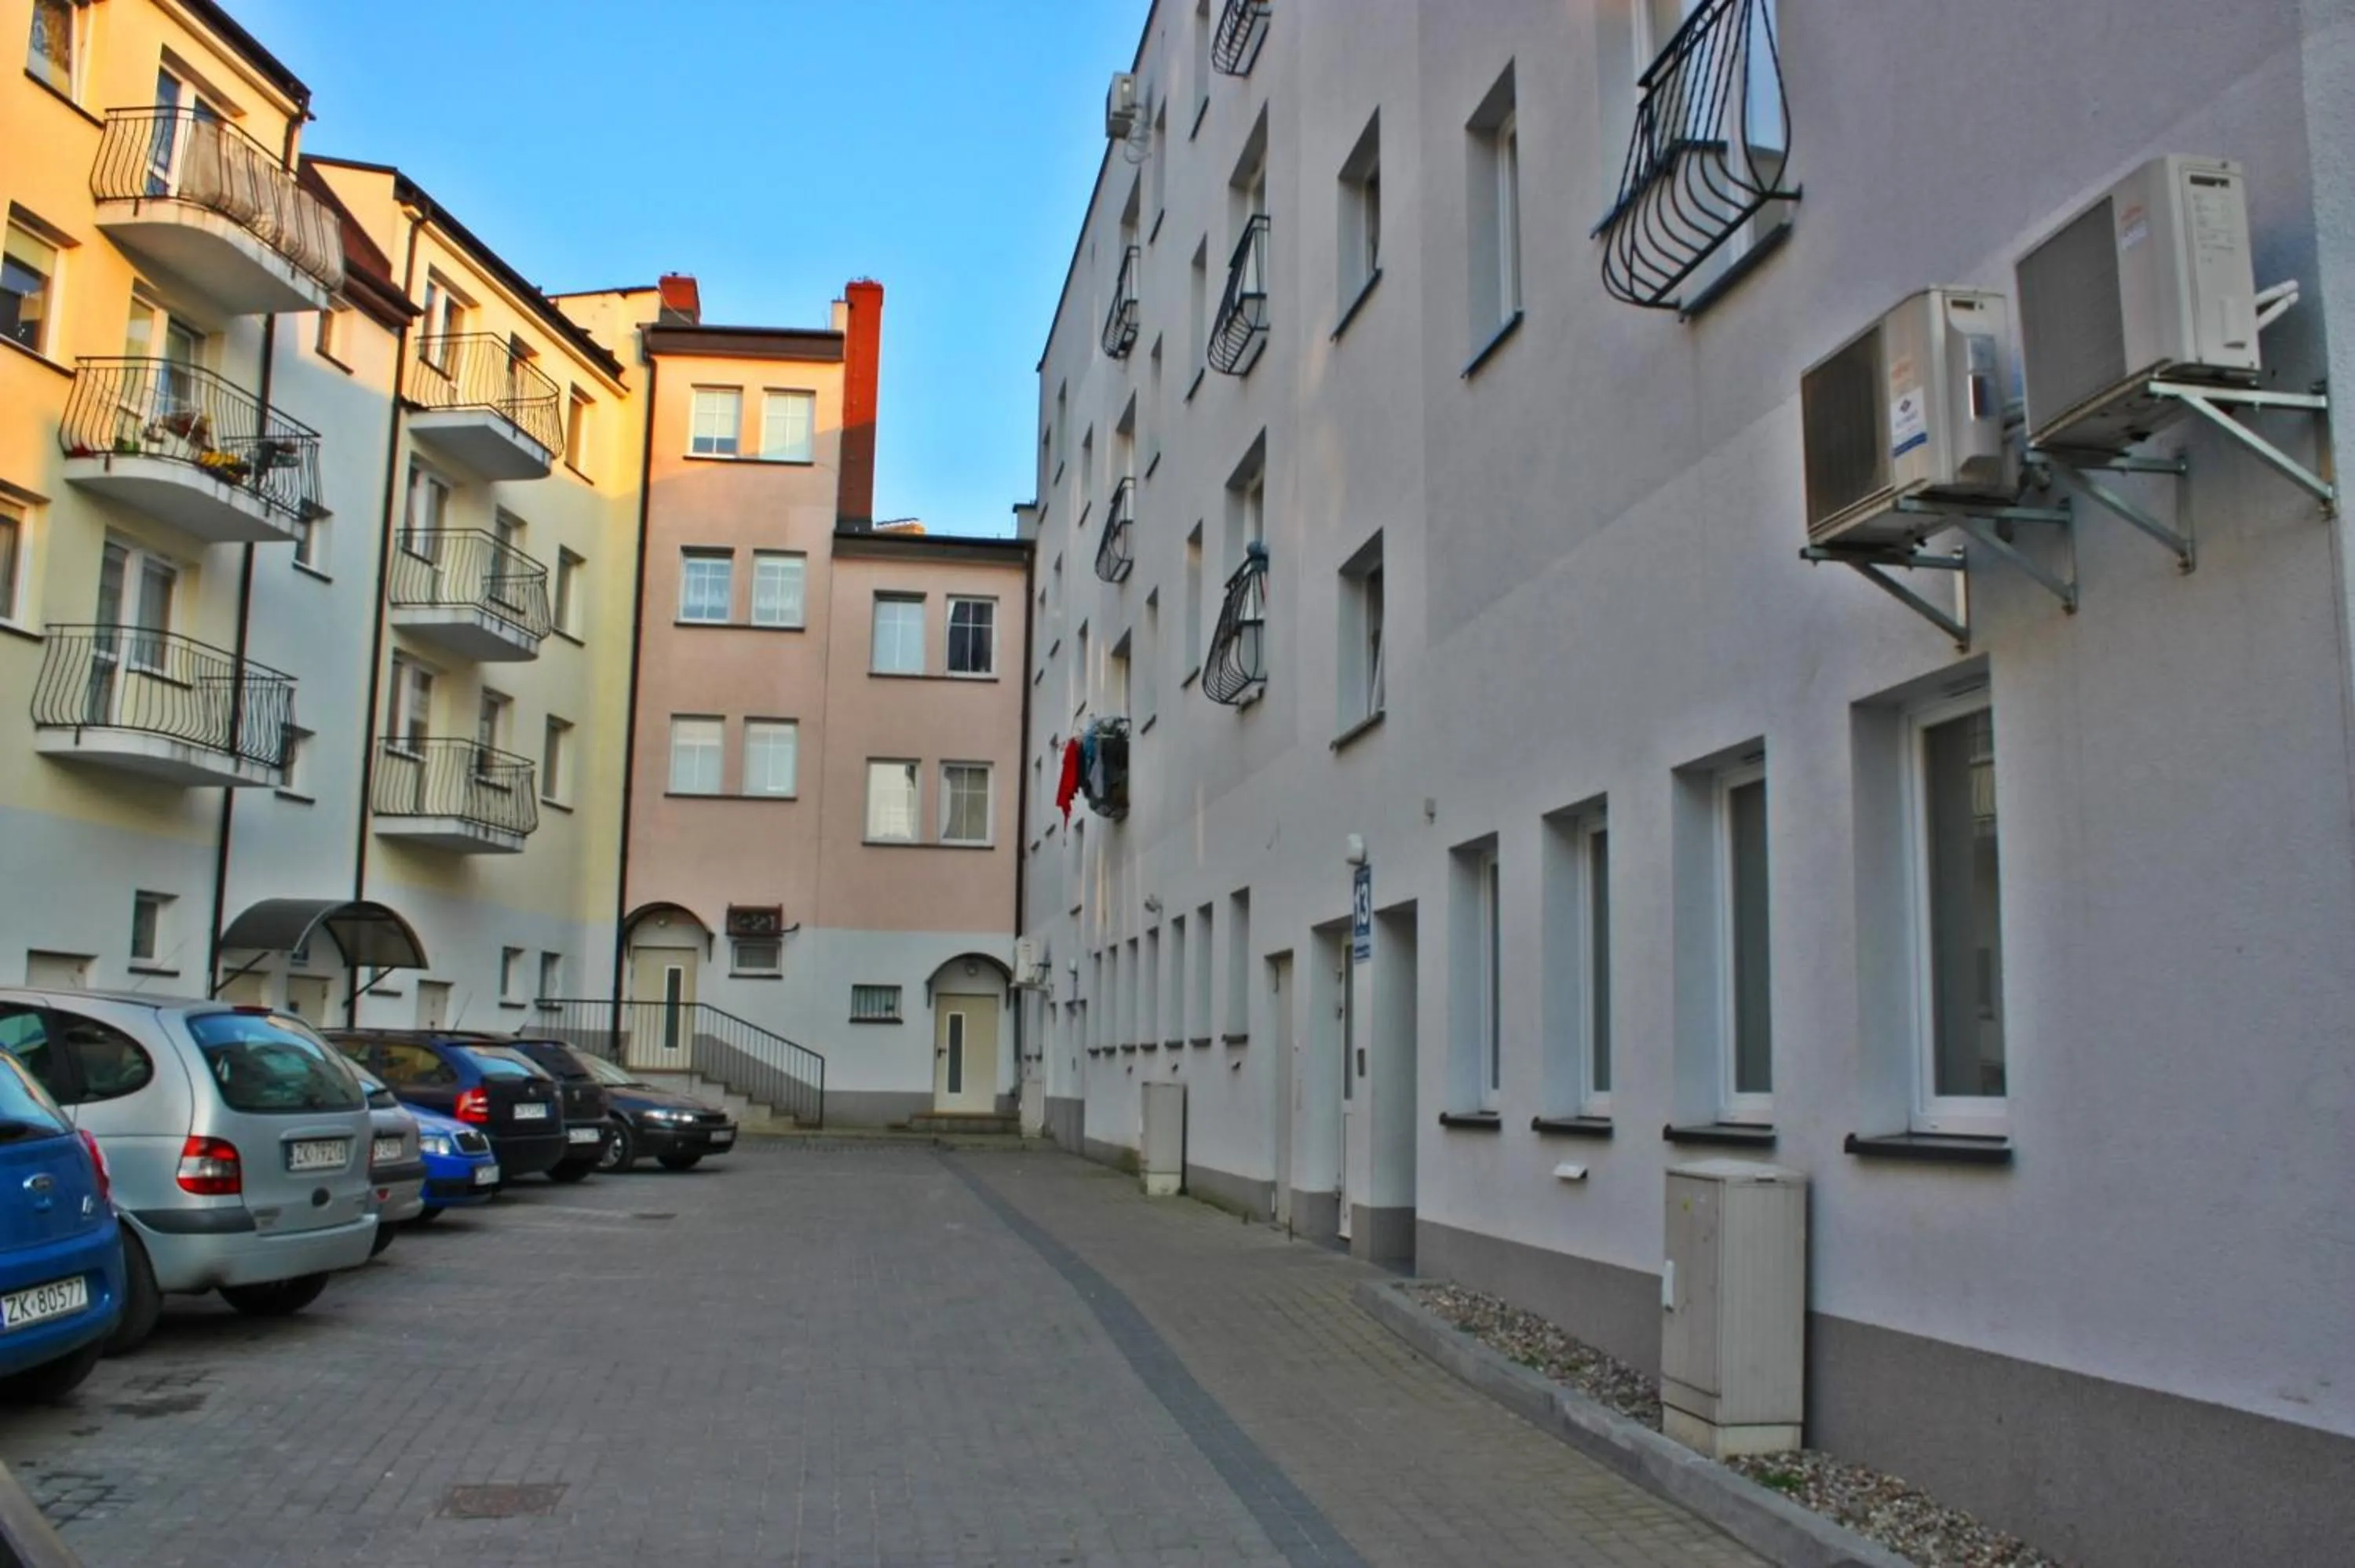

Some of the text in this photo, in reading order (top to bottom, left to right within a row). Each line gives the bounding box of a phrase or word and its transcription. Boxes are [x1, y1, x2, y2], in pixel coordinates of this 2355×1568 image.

[1355, 882, 1369, 927] 13
[5, 1278, 82, 1322] ZK 80577
